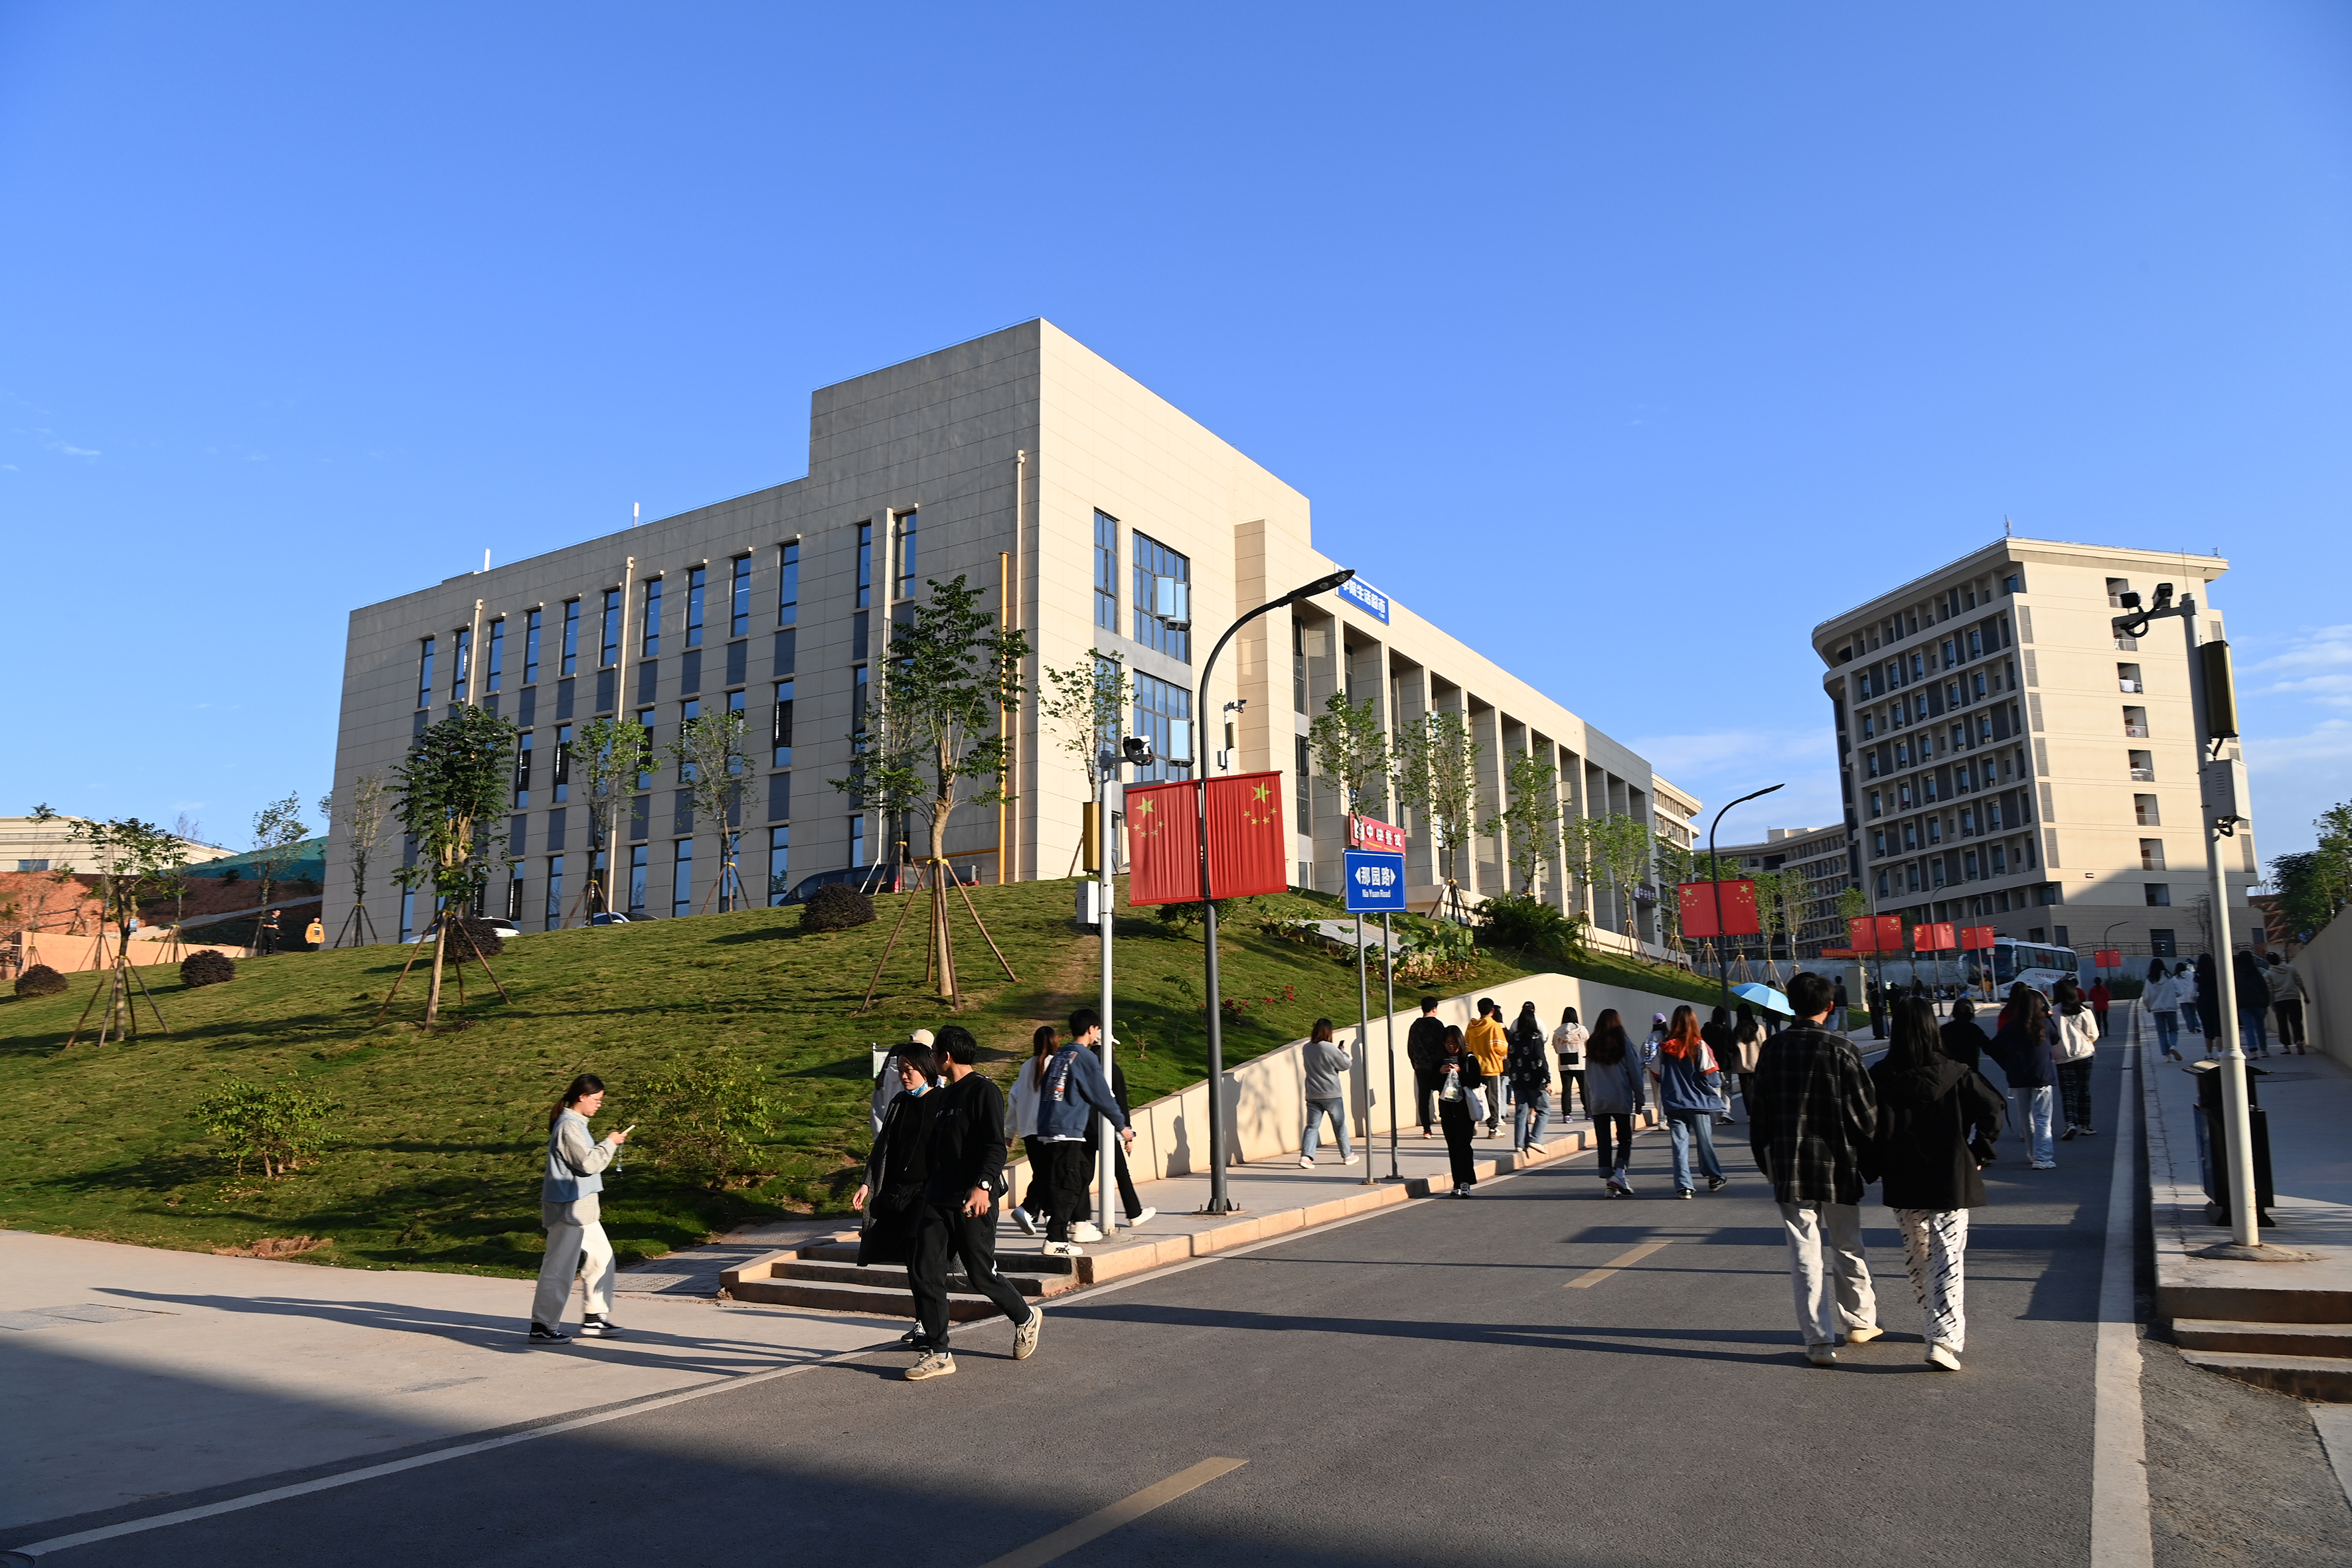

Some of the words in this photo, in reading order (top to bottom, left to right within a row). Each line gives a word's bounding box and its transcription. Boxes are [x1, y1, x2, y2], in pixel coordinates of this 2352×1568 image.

[1361, 867, 1390, 886] 那园路
[1362, 889, 1369, 898] Na
[1369, 889, 1379, 898] Yuan
[1379, 889, 1391, 898] Road
